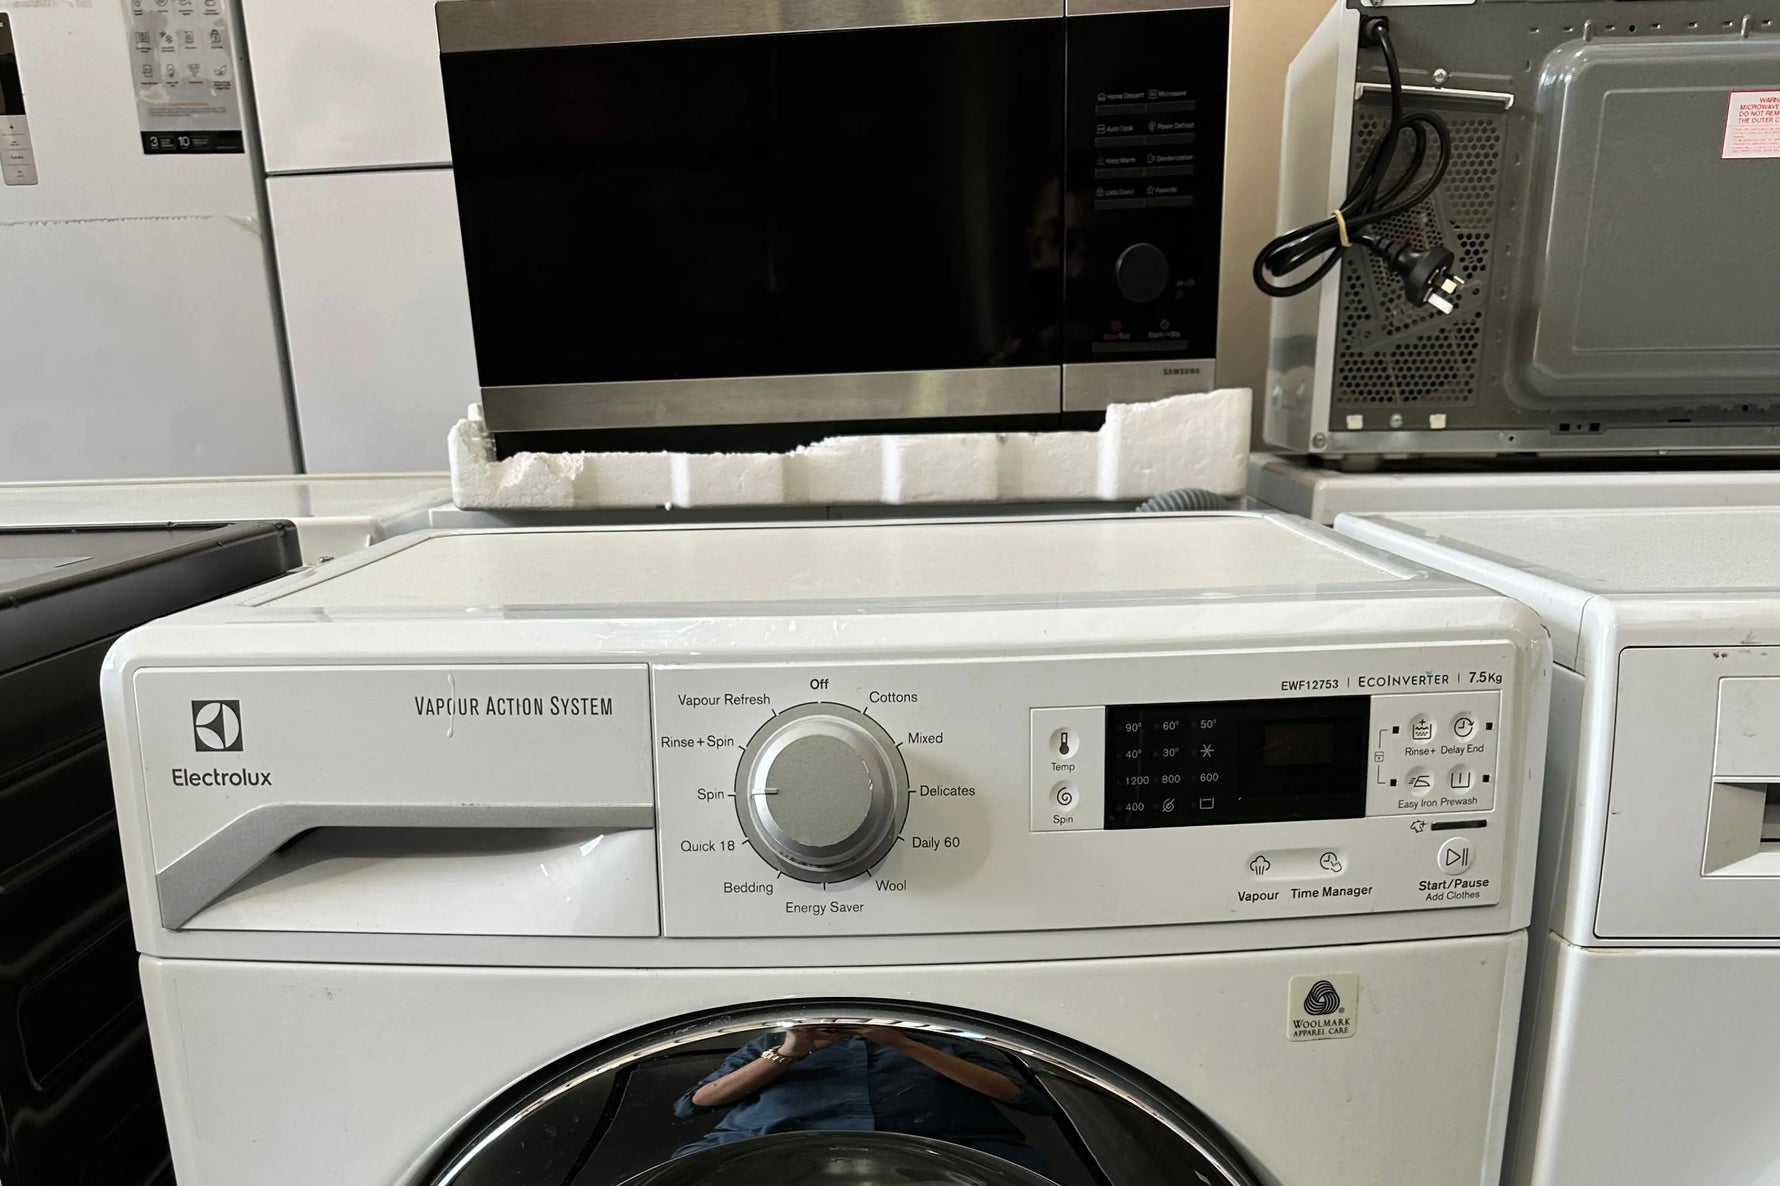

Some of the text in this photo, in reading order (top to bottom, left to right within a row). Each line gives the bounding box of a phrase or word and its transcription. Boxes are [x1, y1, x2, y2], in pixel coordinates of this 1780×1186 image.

[150, 136, 158, 147] 3
[178, 136, 190, 147] 10
[1164, 368, 1200, 376] SAMSUNG
[810, 678, 830, 690] Off
[1281, 680, 1339, 691] EWF12753
[678, 693, 771, 708] Vapour Refresh
[869, 690, 918, 704] Cottons
[486, 696, 544, 716] ACTION
[550, 696, 613, 716] SYSTEM
[908, 732, 944, 744] Mixed
[1440, 745, 1464, 756] Delay
[1466, 744, 1484, 753] End
[1051, 762, 1076, 772] Temp
[172, 768, 272, 786] Electrolux
[1125, 776, 1150, 786] 1200
[1162, 774, 1181, 784] 800
[1200, 772, 1219, 782] 600
[697, 788, 724, 802] Spin
[920, 785, 976, 797] Delicates
[1125, 802, 1144, 812] 400
[1398, 797, 1478, 810] Easy Iron Prewash
[1052, 814, 1074, 826] Spin
[680, 840, 735, 852] Quick 18
[912, 836, 960, 851] Daily 60
[723, 882, 774, 896] Bedding
[875, 880, 907, 892] Wool
[1418, 878, 1490, 892] Start/Pause
[1238, 885, 1373, 903] Vapour Time Manager
[1425, 890, 1480, 902] Add Clothes
[785, 901, 864, 916] Energy Saver
[1292, 1018, 1350, 1029] WOOLMARK
[1293, 1026, 1348, 1037] APPAREL CARE
